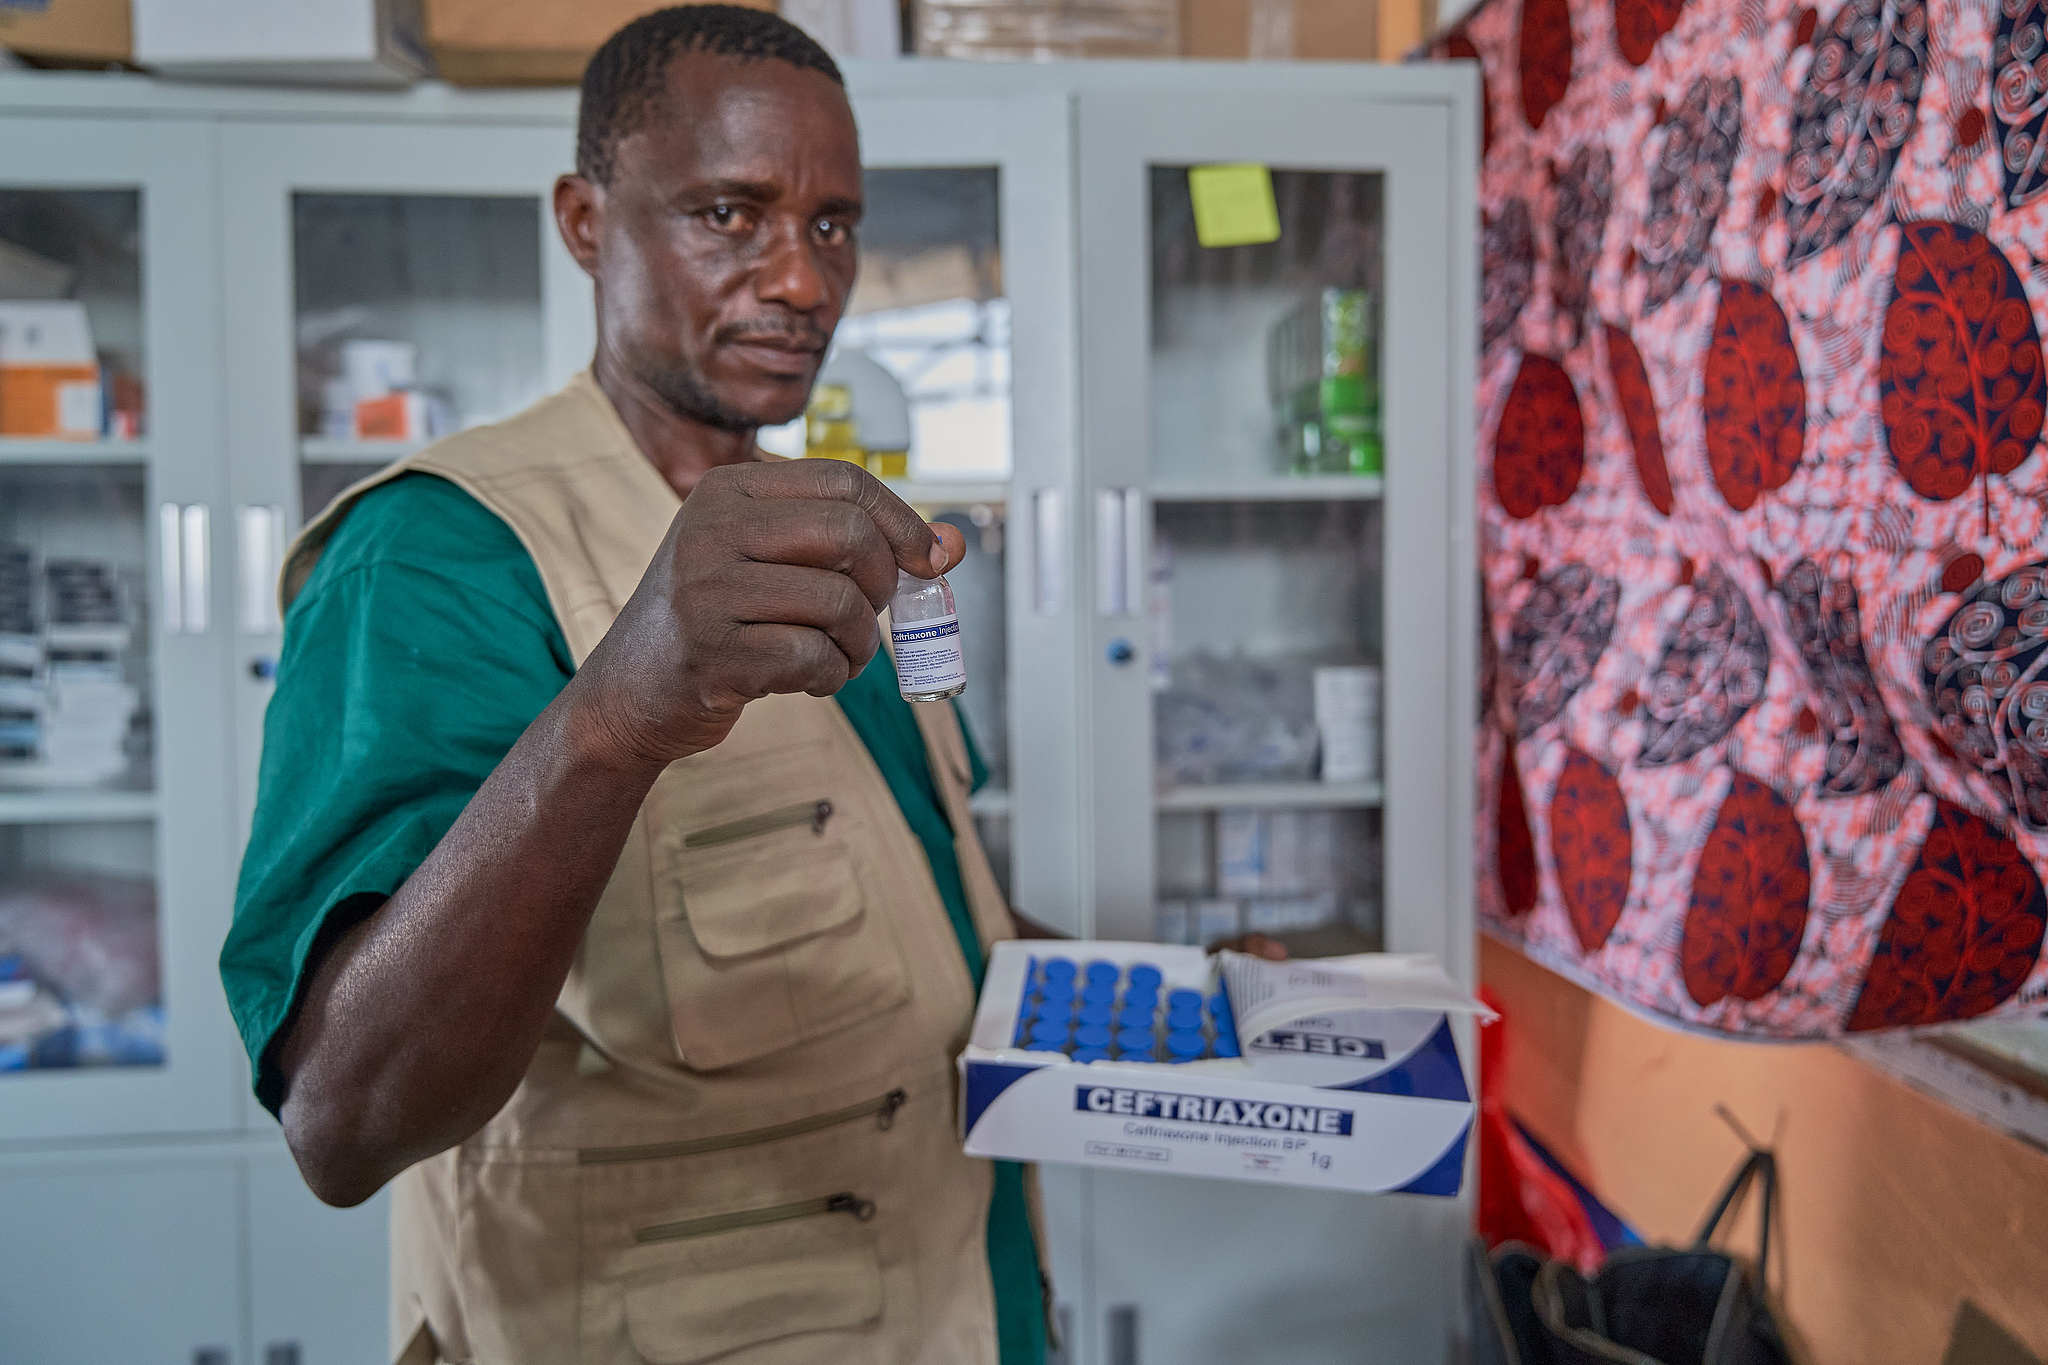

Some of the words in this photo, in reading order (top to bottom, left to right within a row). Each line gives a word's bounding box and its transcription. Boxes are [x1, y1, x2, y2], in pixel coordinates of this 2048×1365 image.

[893, 630, 937, 641] Ceftriaxone
[1087, 1087, 1343, 1133] CEFTRIAXONE
[1283, 1137, 1307, 1150] BP
[1311, 1151, 1331, 1170] 1g
